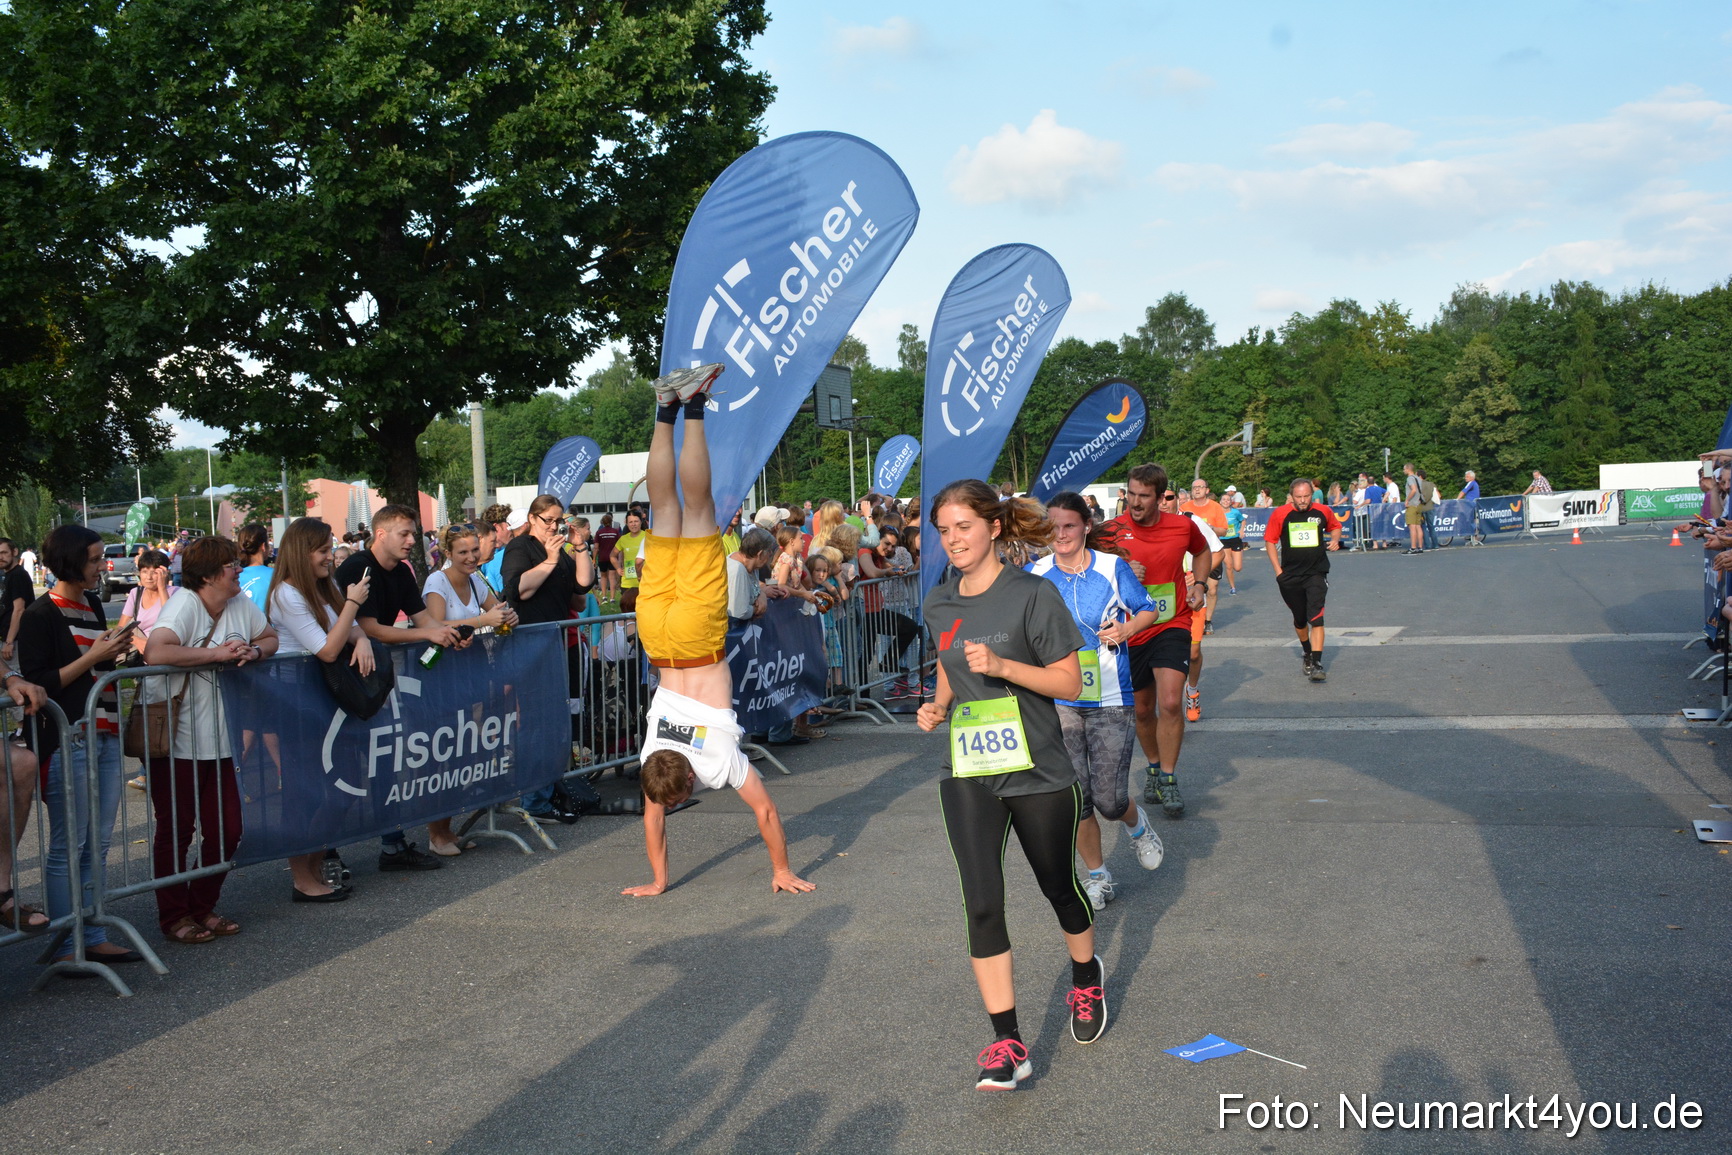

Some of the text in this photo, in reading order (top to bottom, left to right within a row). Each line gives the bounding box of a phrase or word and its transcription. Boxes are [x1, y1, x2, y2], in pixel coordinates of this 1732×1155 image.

[724, 180, 863, 378] Fischer
[773, 219, 879, 376] AUTOMOBILE
[961, 274, 1038, 412] Fischer
[991, 299, 1048, 410] AUTOMOBILE
[885, 443, 910, 482] Fischer
[1041, 425, 1117, 490] Frischmann
[1090, 445, 1109, 462] Druck
[1120, 419, 1142, 439] Medien
[553, 446, 588, 494] Fischer
[565, 455, 592, 493] AUTOMOBILE
[1478, 508, 1512, 520] Frischmann
[1563, 499, 1597, 517] swn
[1631, 495, 1656, 508] AOK
[1298, 532, 1309, 540] 33
[368, 709, 516, 778] Fischer
[958, 728, 1018, 756] 1488
[385, 756, 509, 806] AUTOMOBILE
